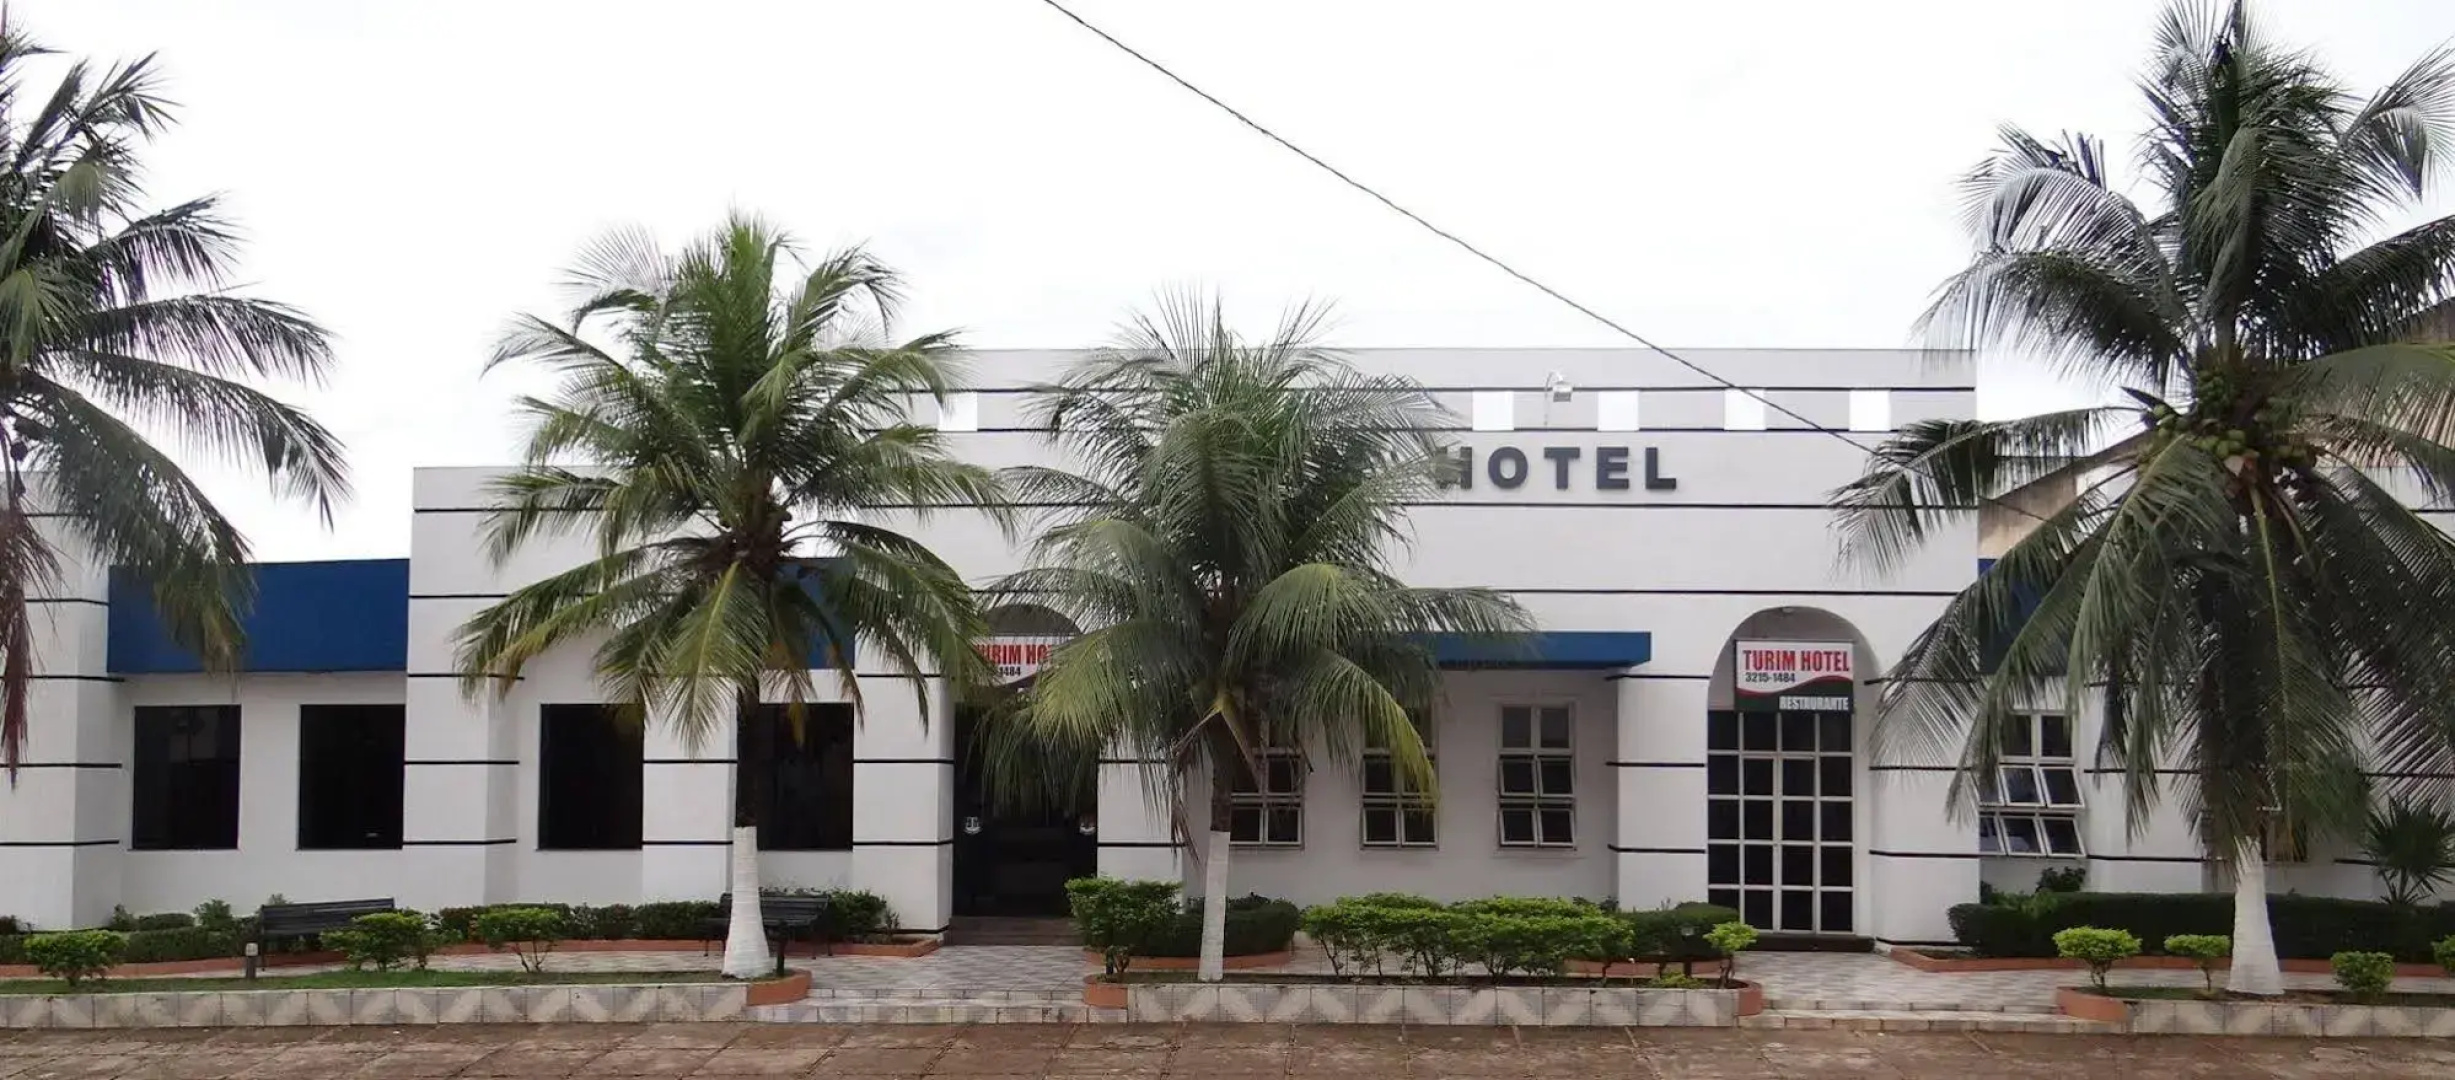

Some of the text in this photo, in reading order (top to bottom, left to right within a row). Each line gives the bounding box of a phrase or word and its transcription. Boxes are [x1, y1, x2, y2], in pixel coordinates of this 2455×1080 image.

[1026, 644, 1052, 665] HO
[1743, 650, 1849, 671] TURIM HOTEL
[1745, 672, 1795, 683] 3215-1484
[1779, 696, 1849, 710] RESTAURANTE
